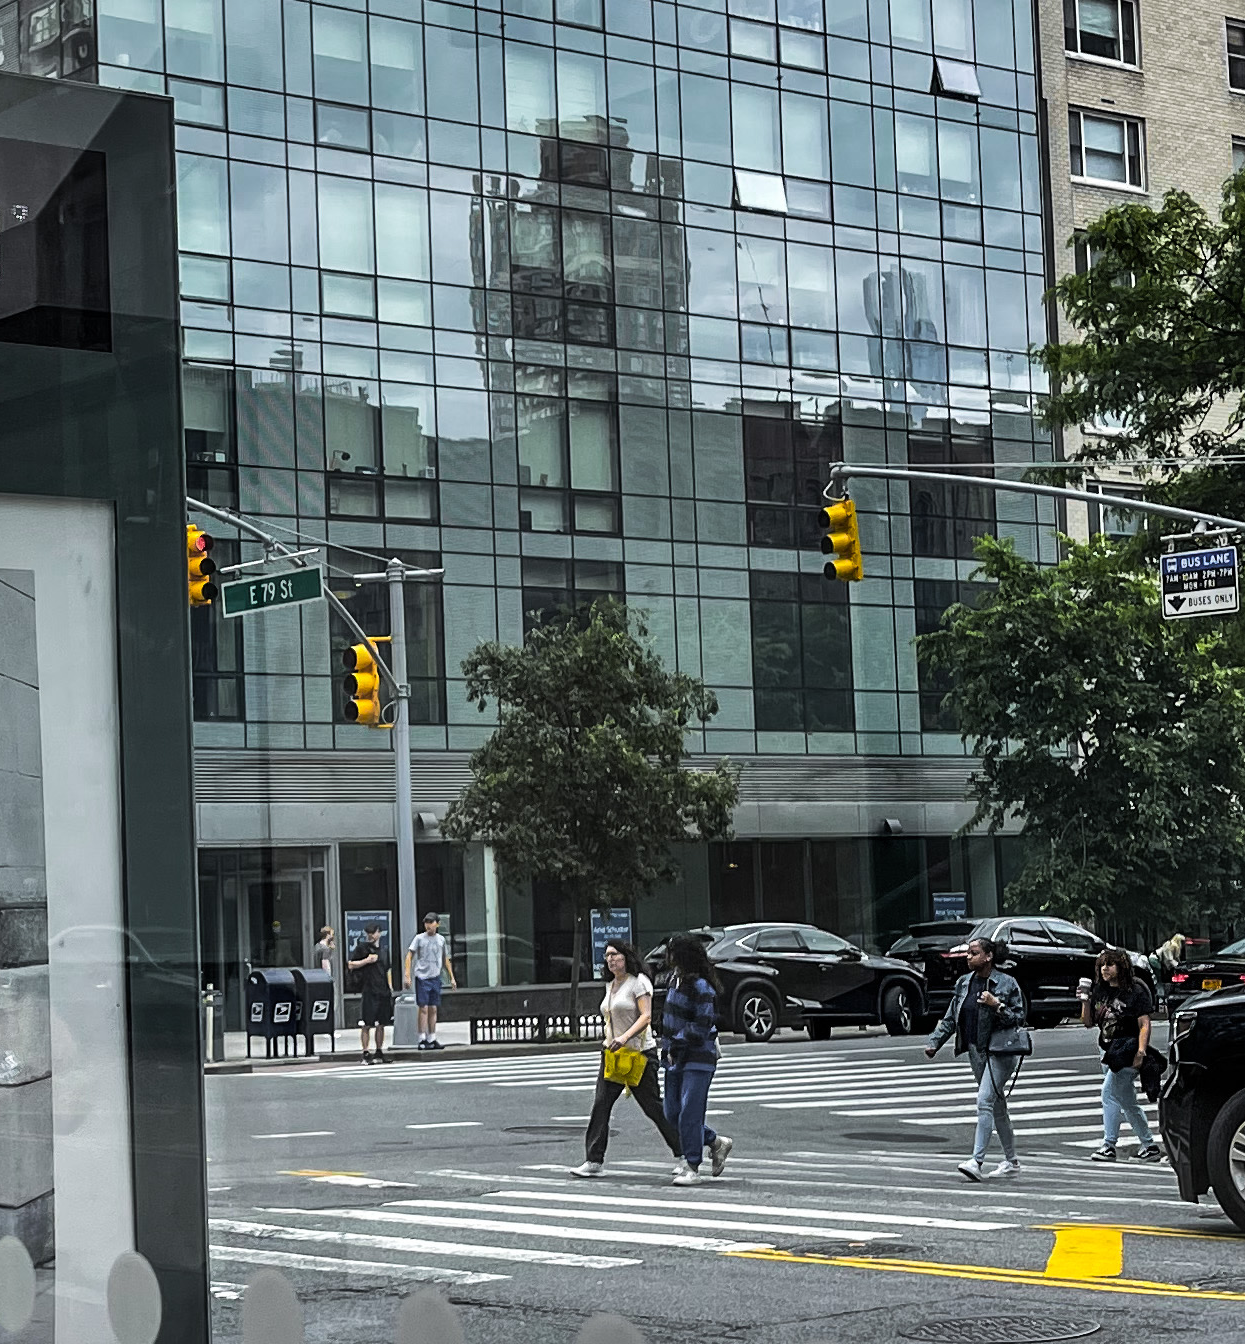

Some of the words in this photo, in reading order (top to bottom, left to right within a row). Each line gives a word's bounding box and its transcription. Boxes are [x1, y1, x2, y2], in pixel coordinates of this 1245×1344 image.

[1180, 556, 1201, 569] BUS
[1203, 552, 1231, 566] LANE
[249, 585, 258, 605] E
[261, 582, 276, 603] 79
[280, 579, 294, 599] St
[1188, 595, 1212, 607] BUSES
[1214, 593, 1233, 605] ONLY
